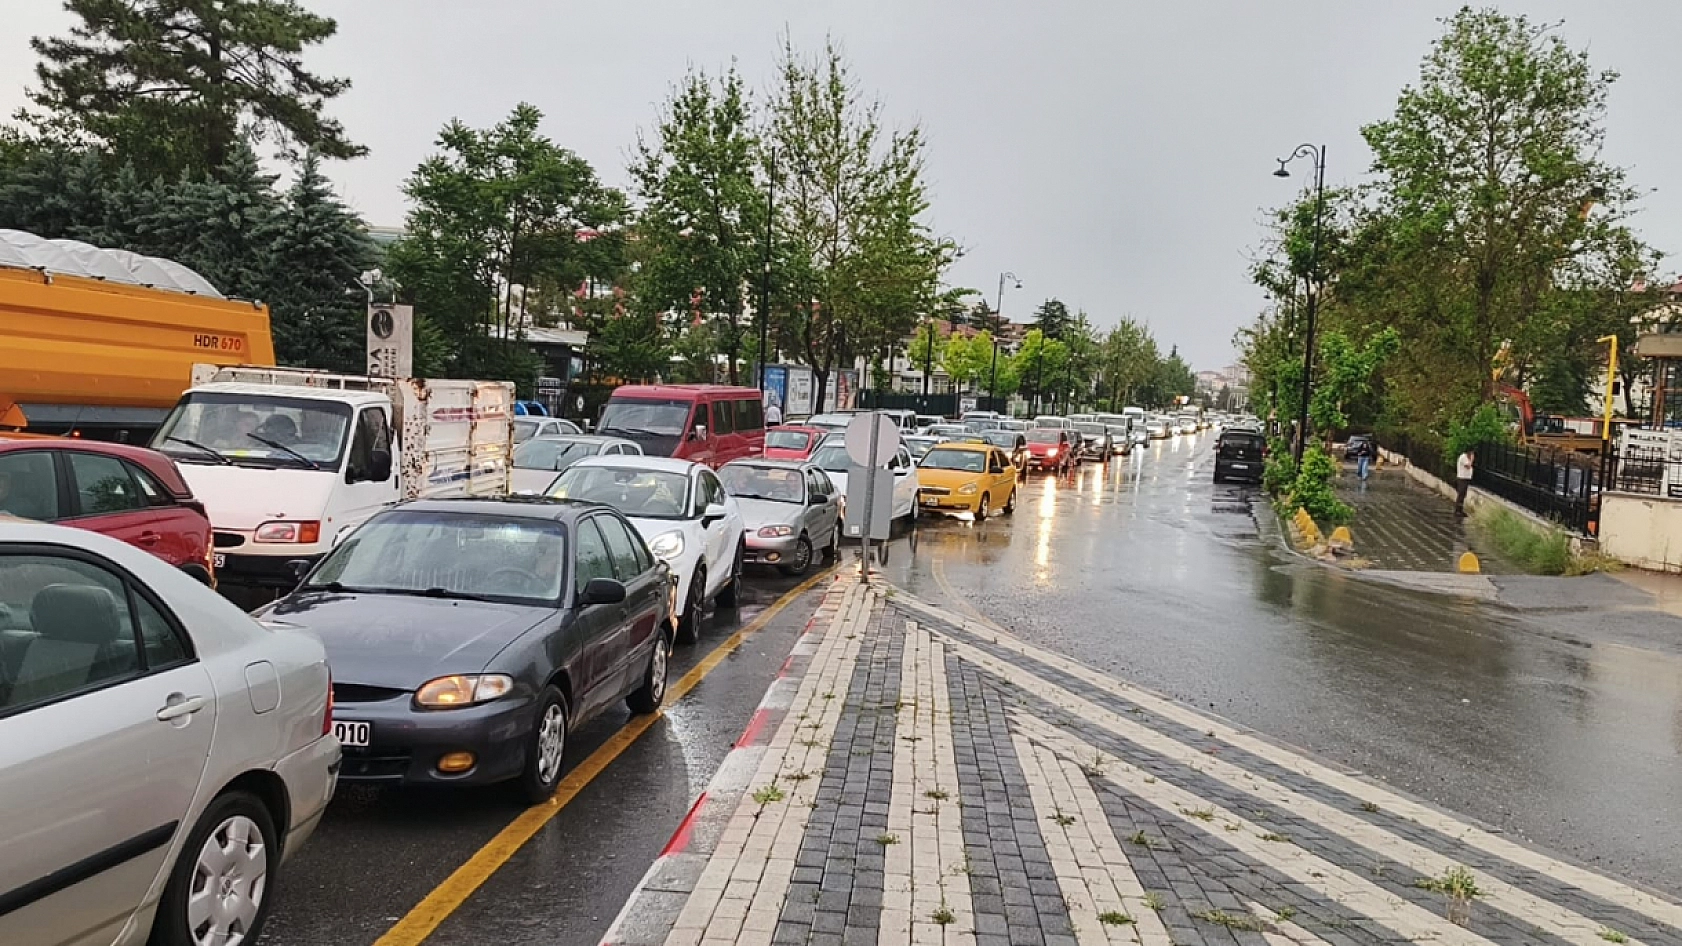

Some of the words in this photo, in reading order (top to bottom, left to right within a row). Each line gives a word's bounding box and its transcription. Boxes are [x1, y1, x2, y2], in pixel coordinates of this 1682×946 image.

[193, 334, 219, 350] HDR
[221, 336, 242, 351] 670
[335, 723, 368, 743] 010
